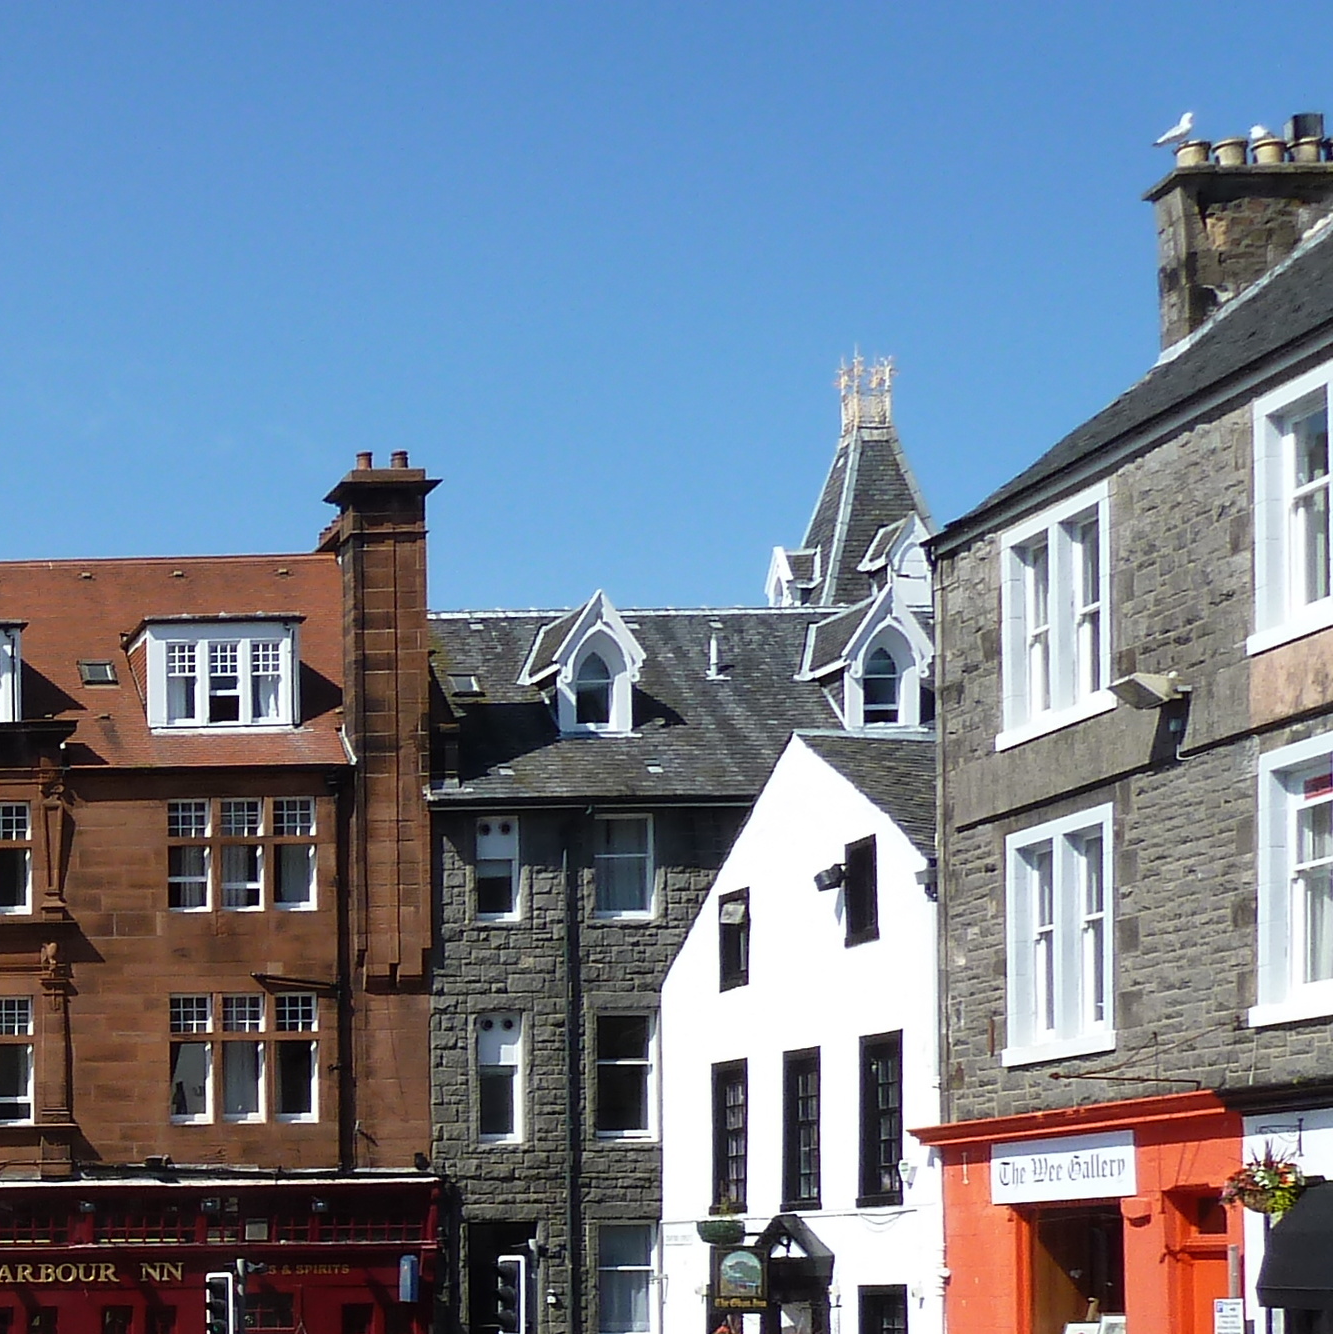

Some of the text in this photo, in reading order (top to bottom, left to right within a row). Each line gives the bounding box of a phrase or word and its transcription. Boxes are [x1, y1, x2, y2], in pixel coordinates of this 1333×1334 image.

[999, 1153, 1126, 1189] The Wee Gallery
[296, 1264, 350, 1275] SPIRITS
